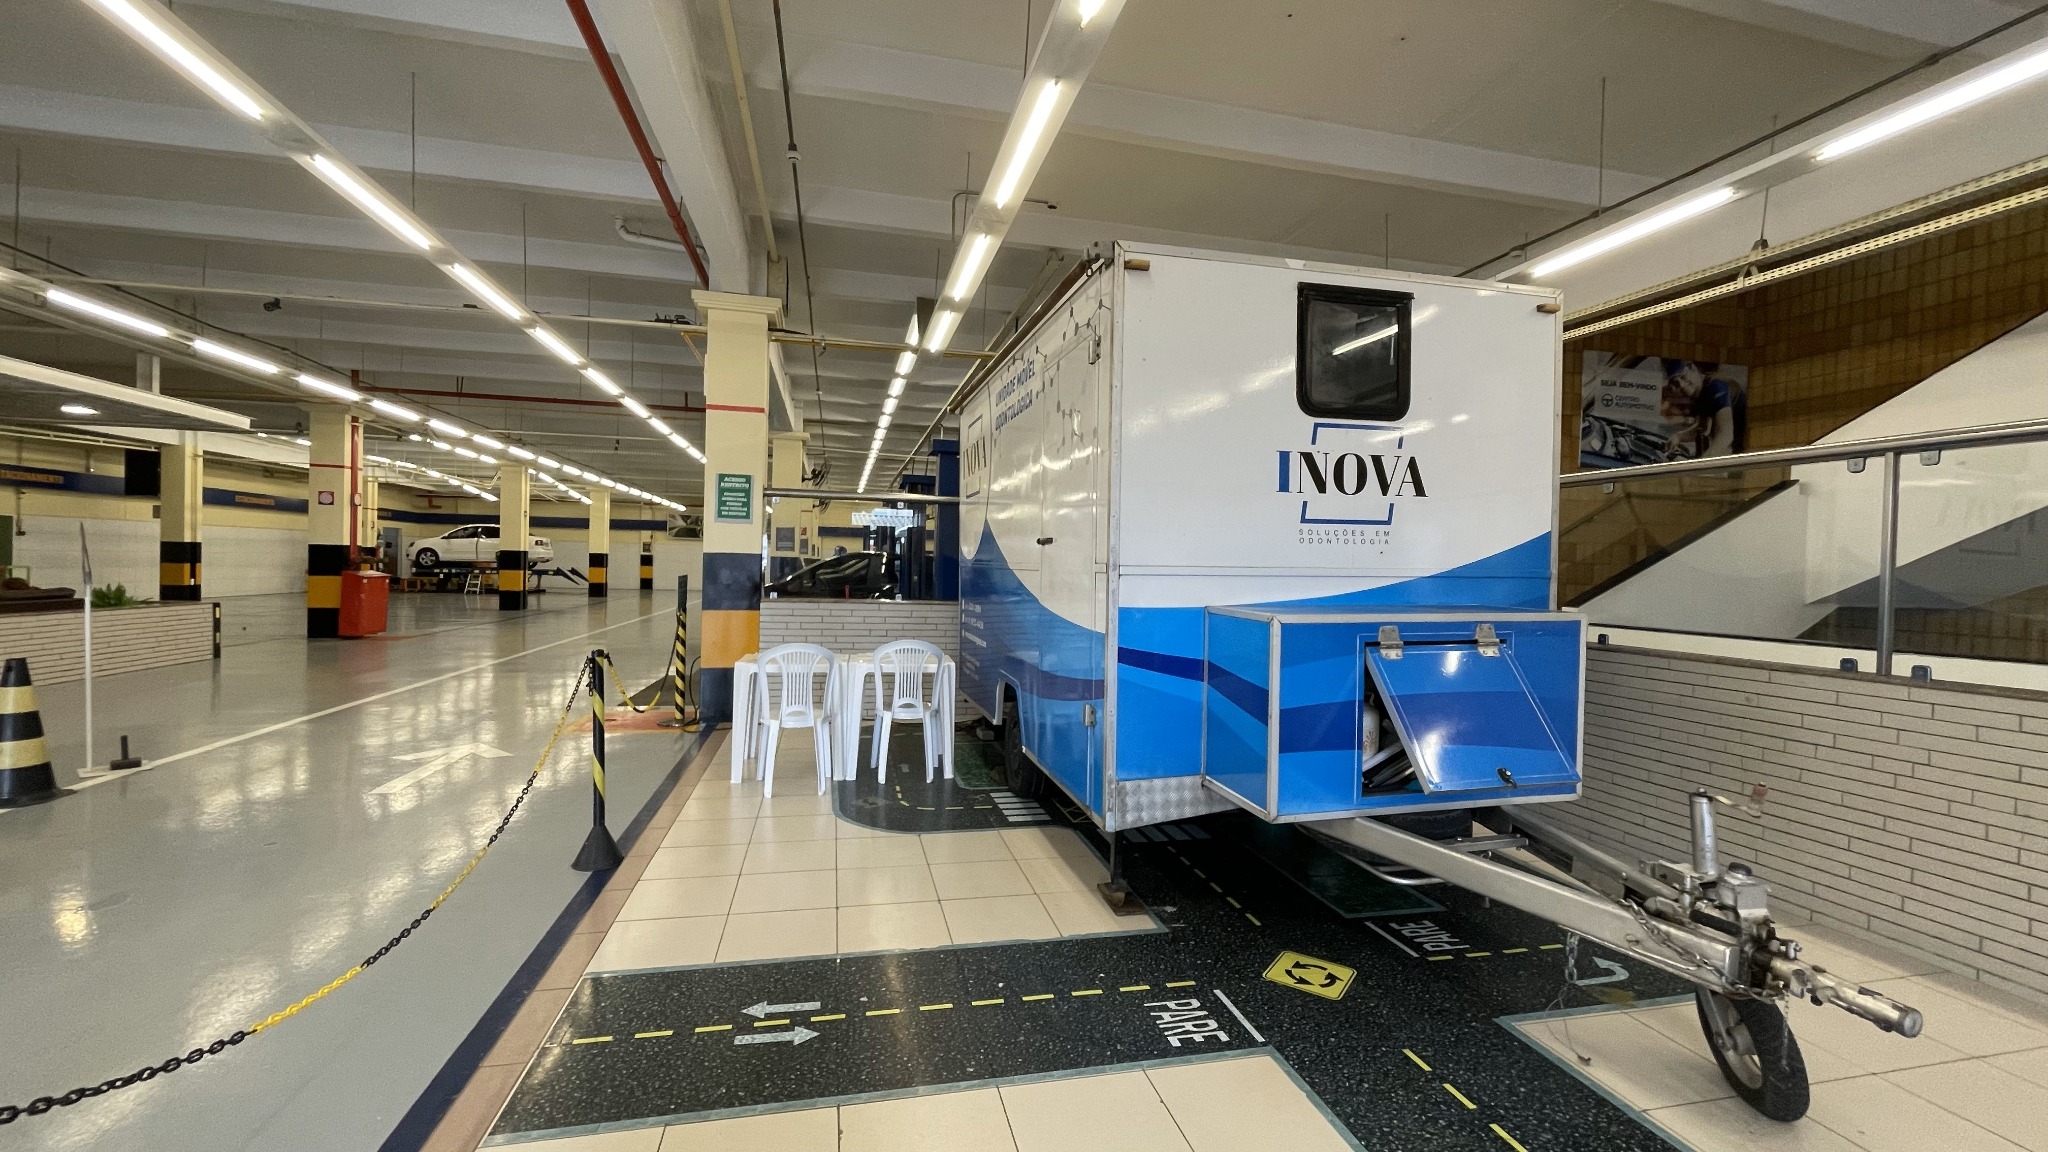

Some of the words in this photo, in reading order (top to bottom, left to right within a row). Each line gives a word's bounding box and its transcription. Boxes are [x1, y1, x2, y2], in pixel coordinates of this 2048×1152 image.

[995, 375, 1017, 407] UNIDADE
[1619, 381, 1656, 391] BEM-VINDO
[1615, 402, 1654, 411] AUTOMOTIVO
[963, 436, 987, 480] INOVA
[1276, 450, 1429, 497] INOVA
[1298, 528, 1365, 538] SOLUÇÕES
[1299, 537, 1390, 545] ODONTOLOGIA
[1388, 920, 1471, 952] PARE
[1143, 998, 1230, 1047] PARE
